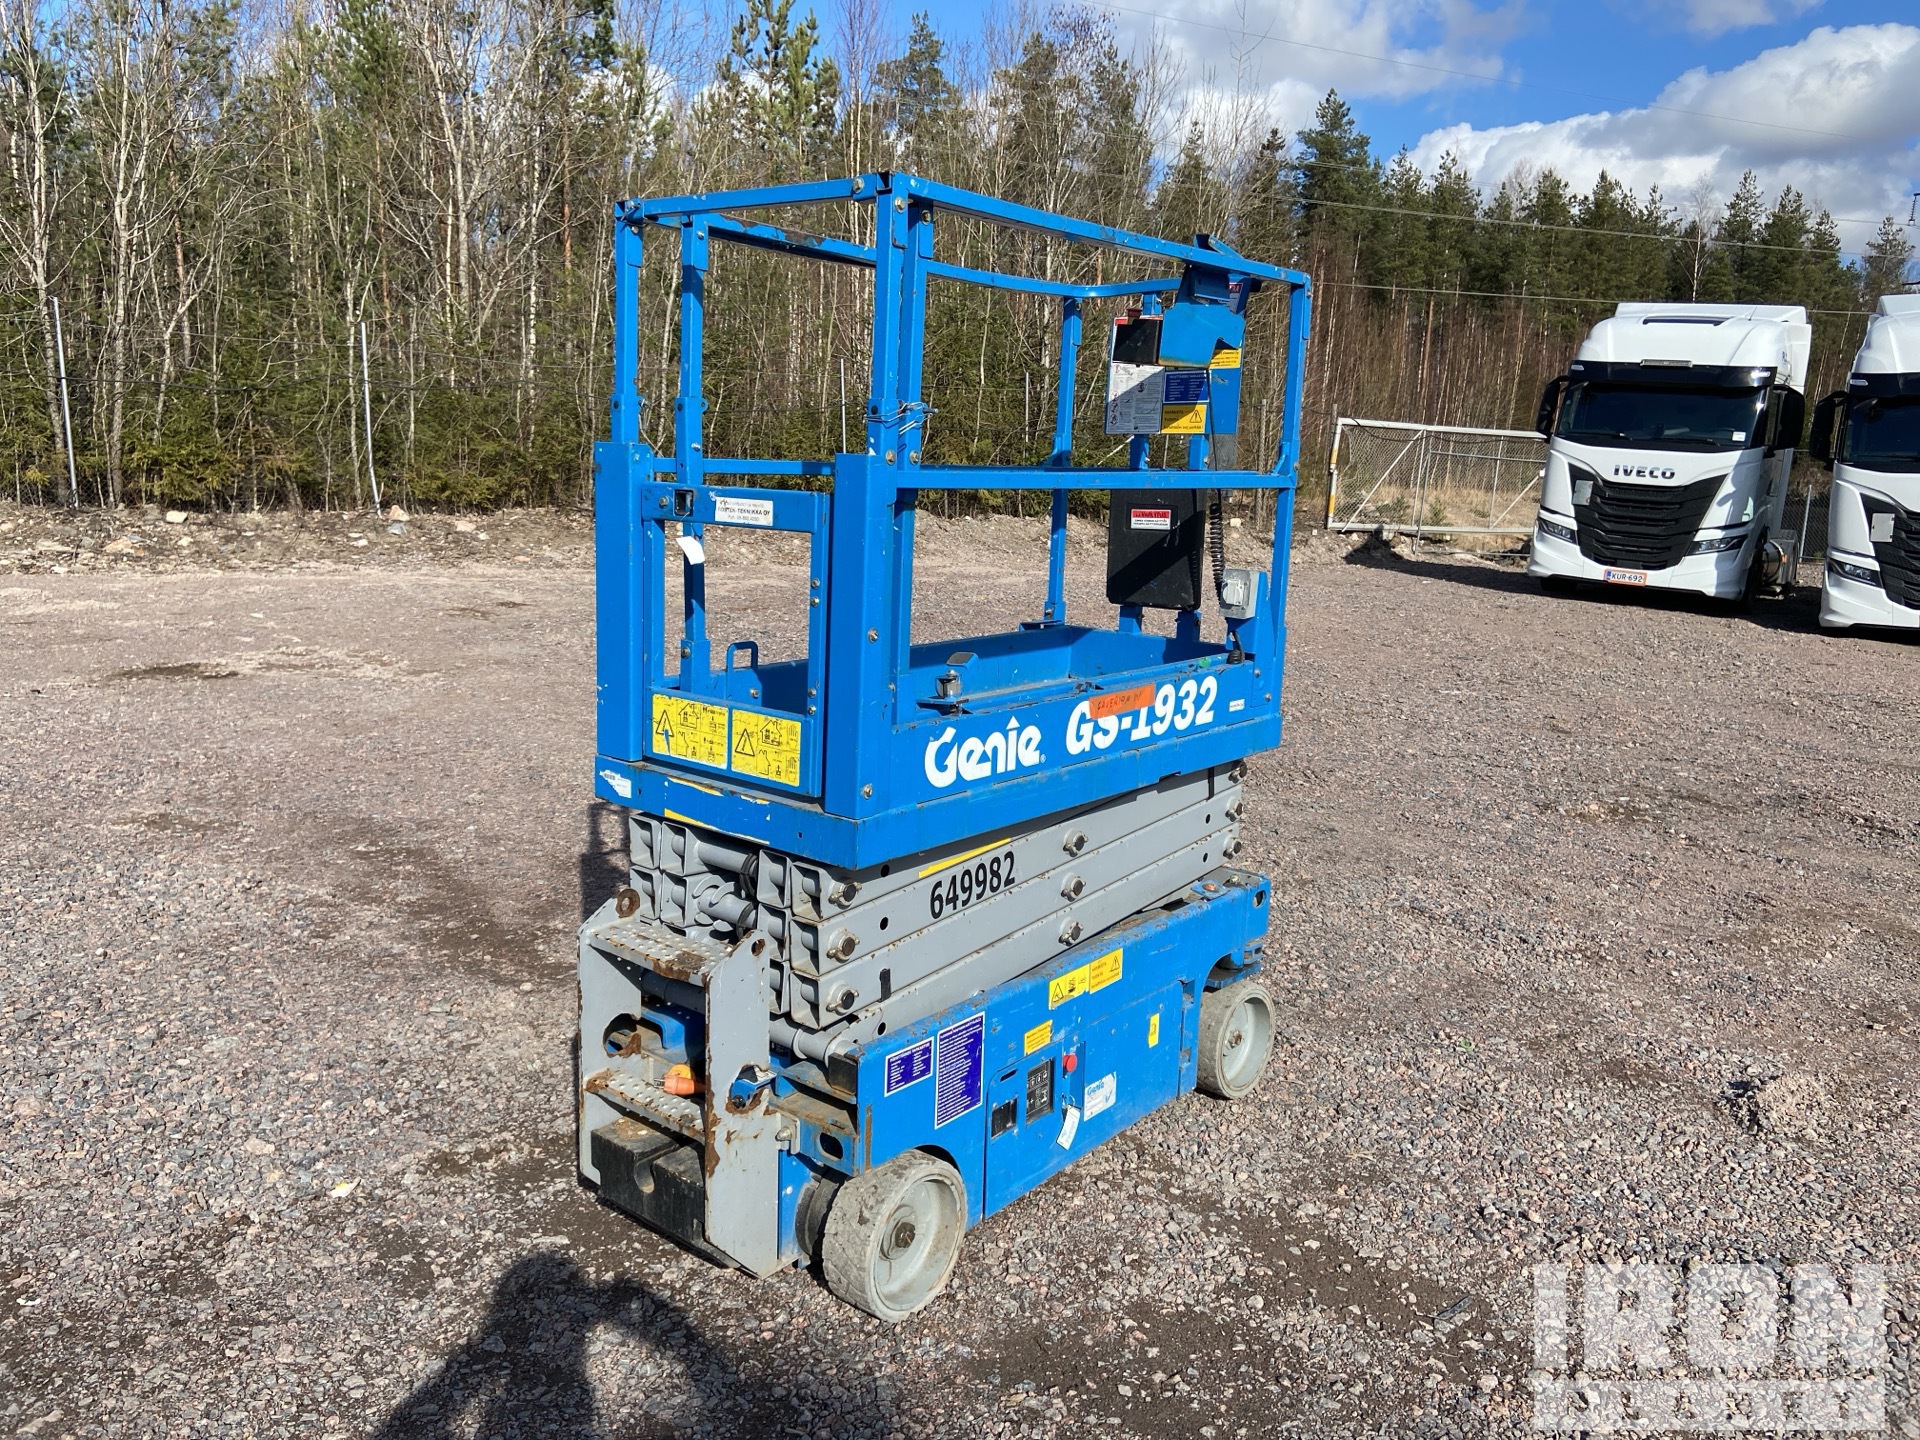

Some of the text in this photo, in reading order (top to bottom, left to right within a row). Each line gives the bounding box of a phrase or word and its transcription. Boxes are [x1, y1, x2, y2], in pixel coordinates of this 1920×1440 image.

[1613, 464, 1676, 480] IVECO
[1611, 572, 1643, 583] KUR-692
[924, 676, 1218, 788] Genie GS-1932
[930, 850, 1016, 919] 649982
